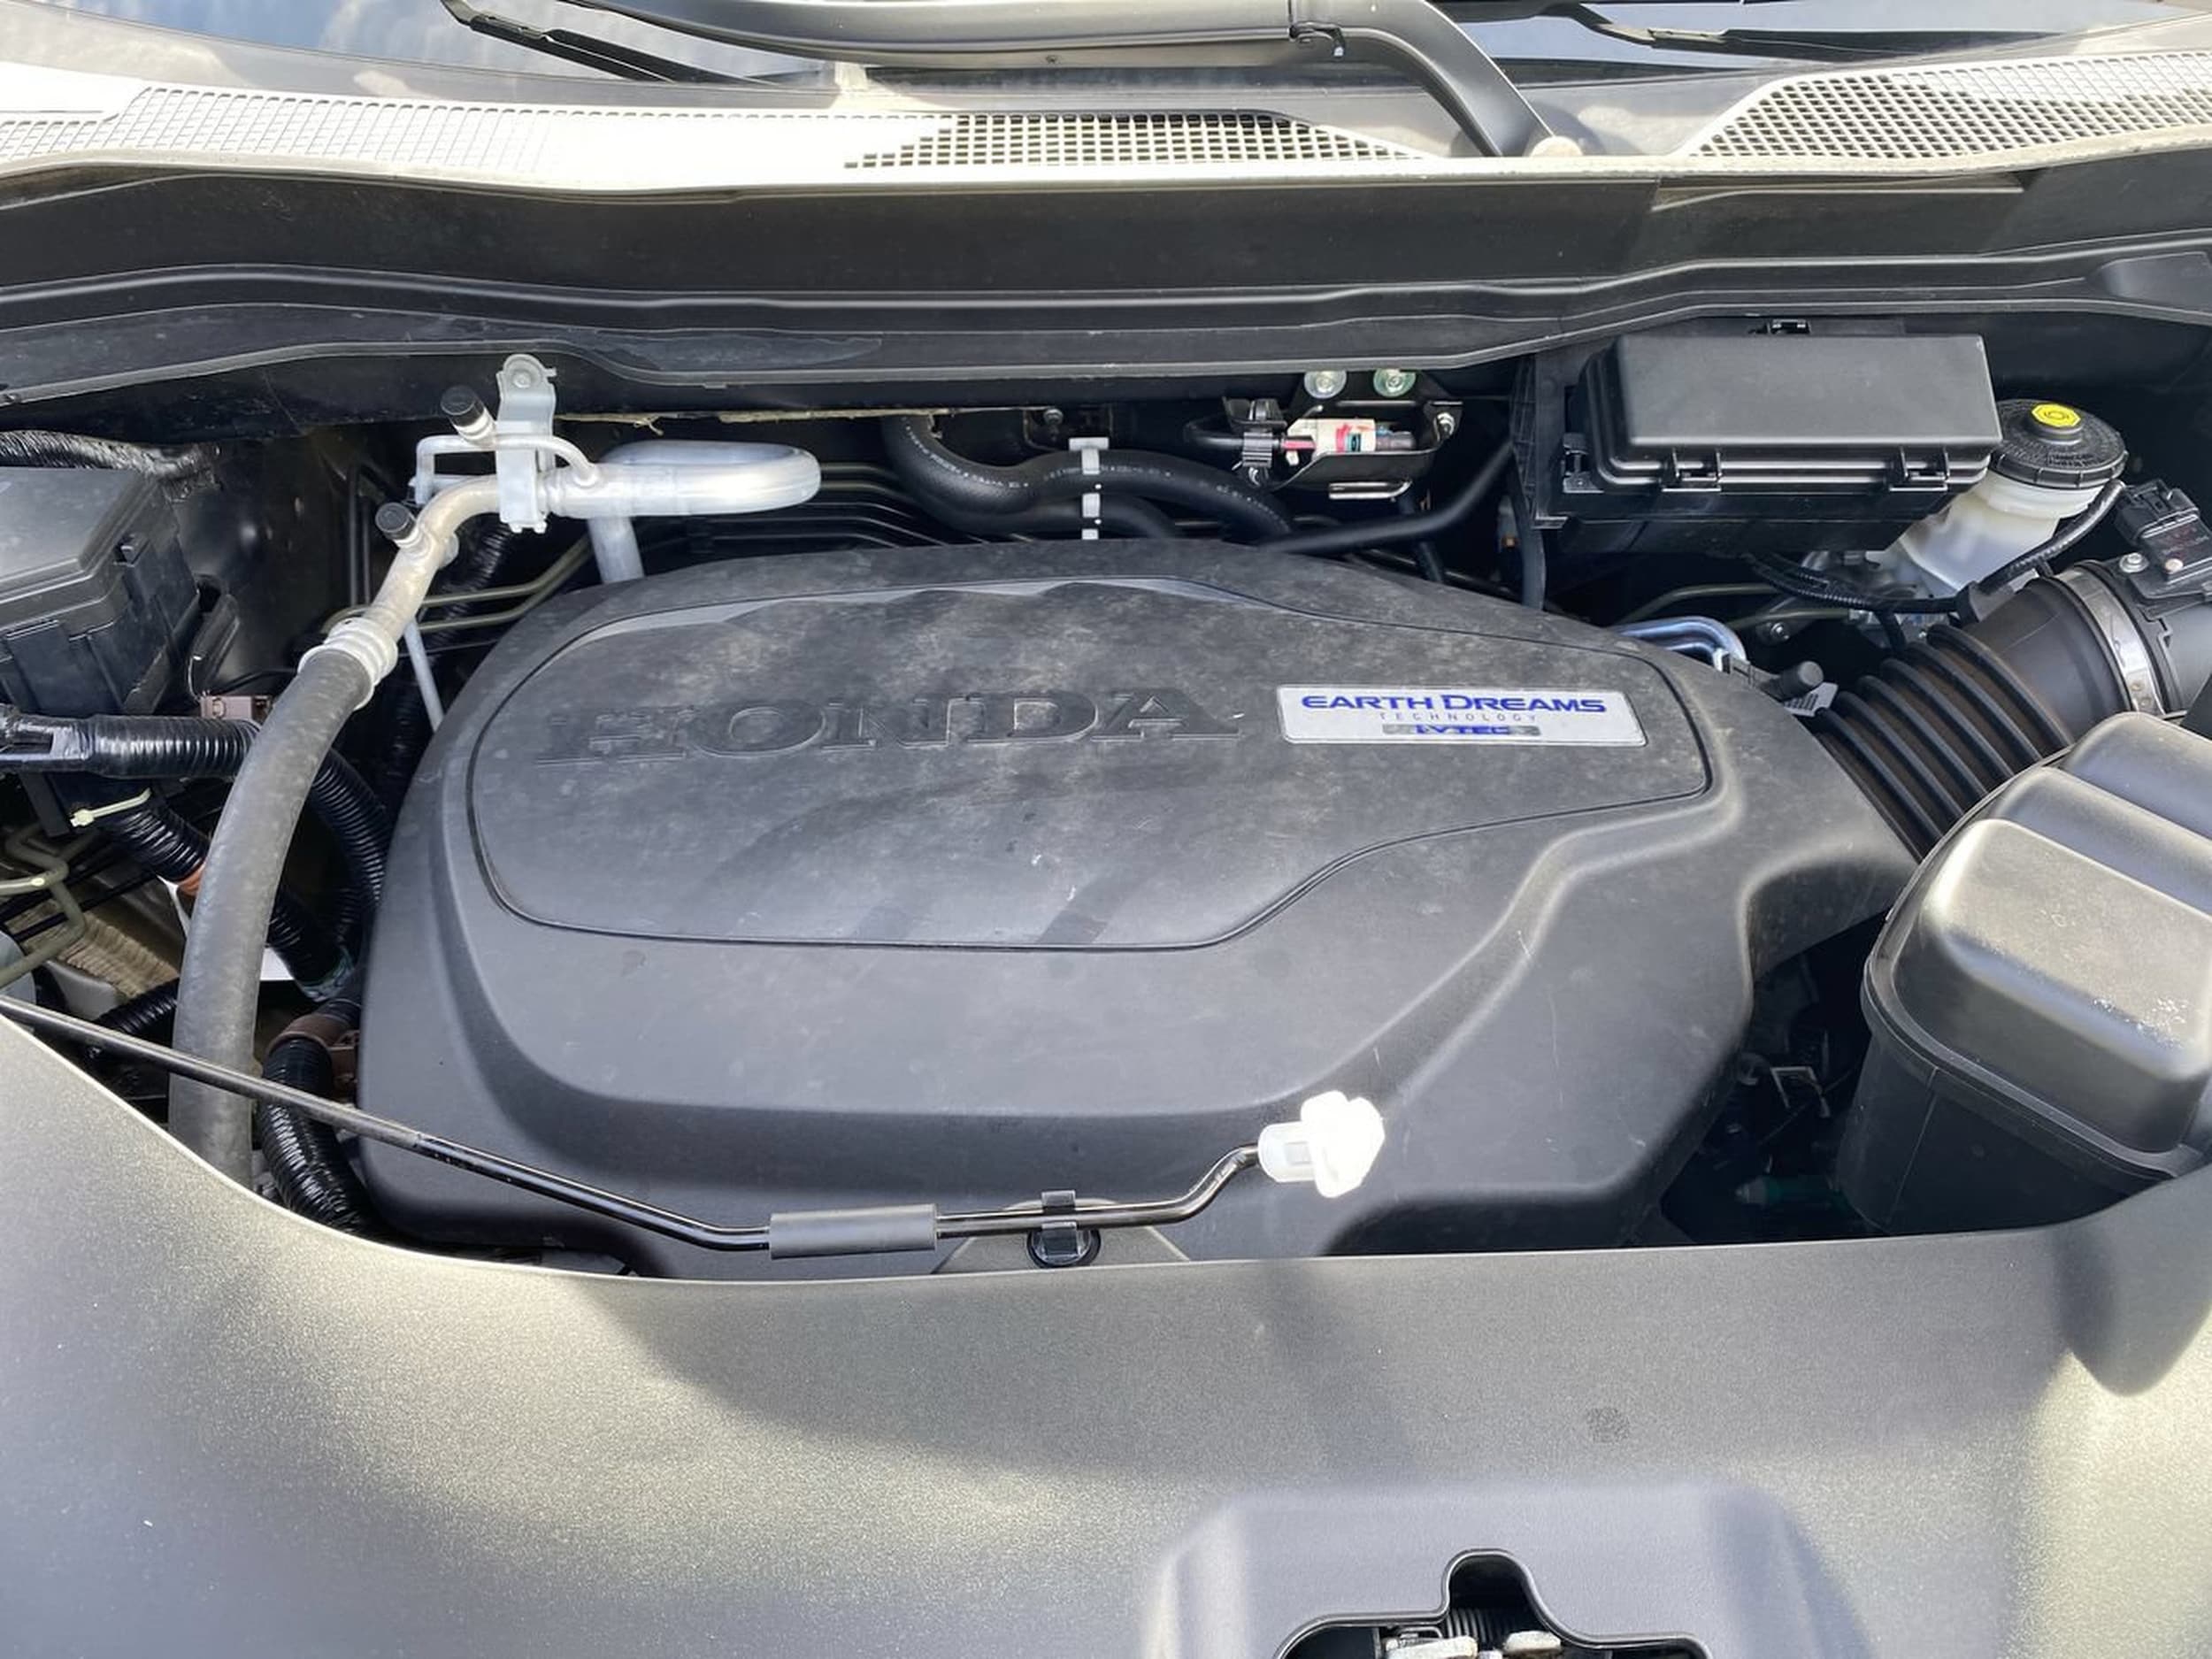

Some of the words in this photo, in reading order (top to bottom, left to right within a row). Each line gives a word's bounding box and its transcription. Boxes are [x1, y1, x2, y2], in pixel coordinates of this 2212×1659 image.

[1301, 695, 1433, 710] EARTH
[1441, 694, 1607, 713] DREAMS
[534, 687, 1240, 766] HONDA
[1379, 712, 1537, 722] TECHNOLOGY
